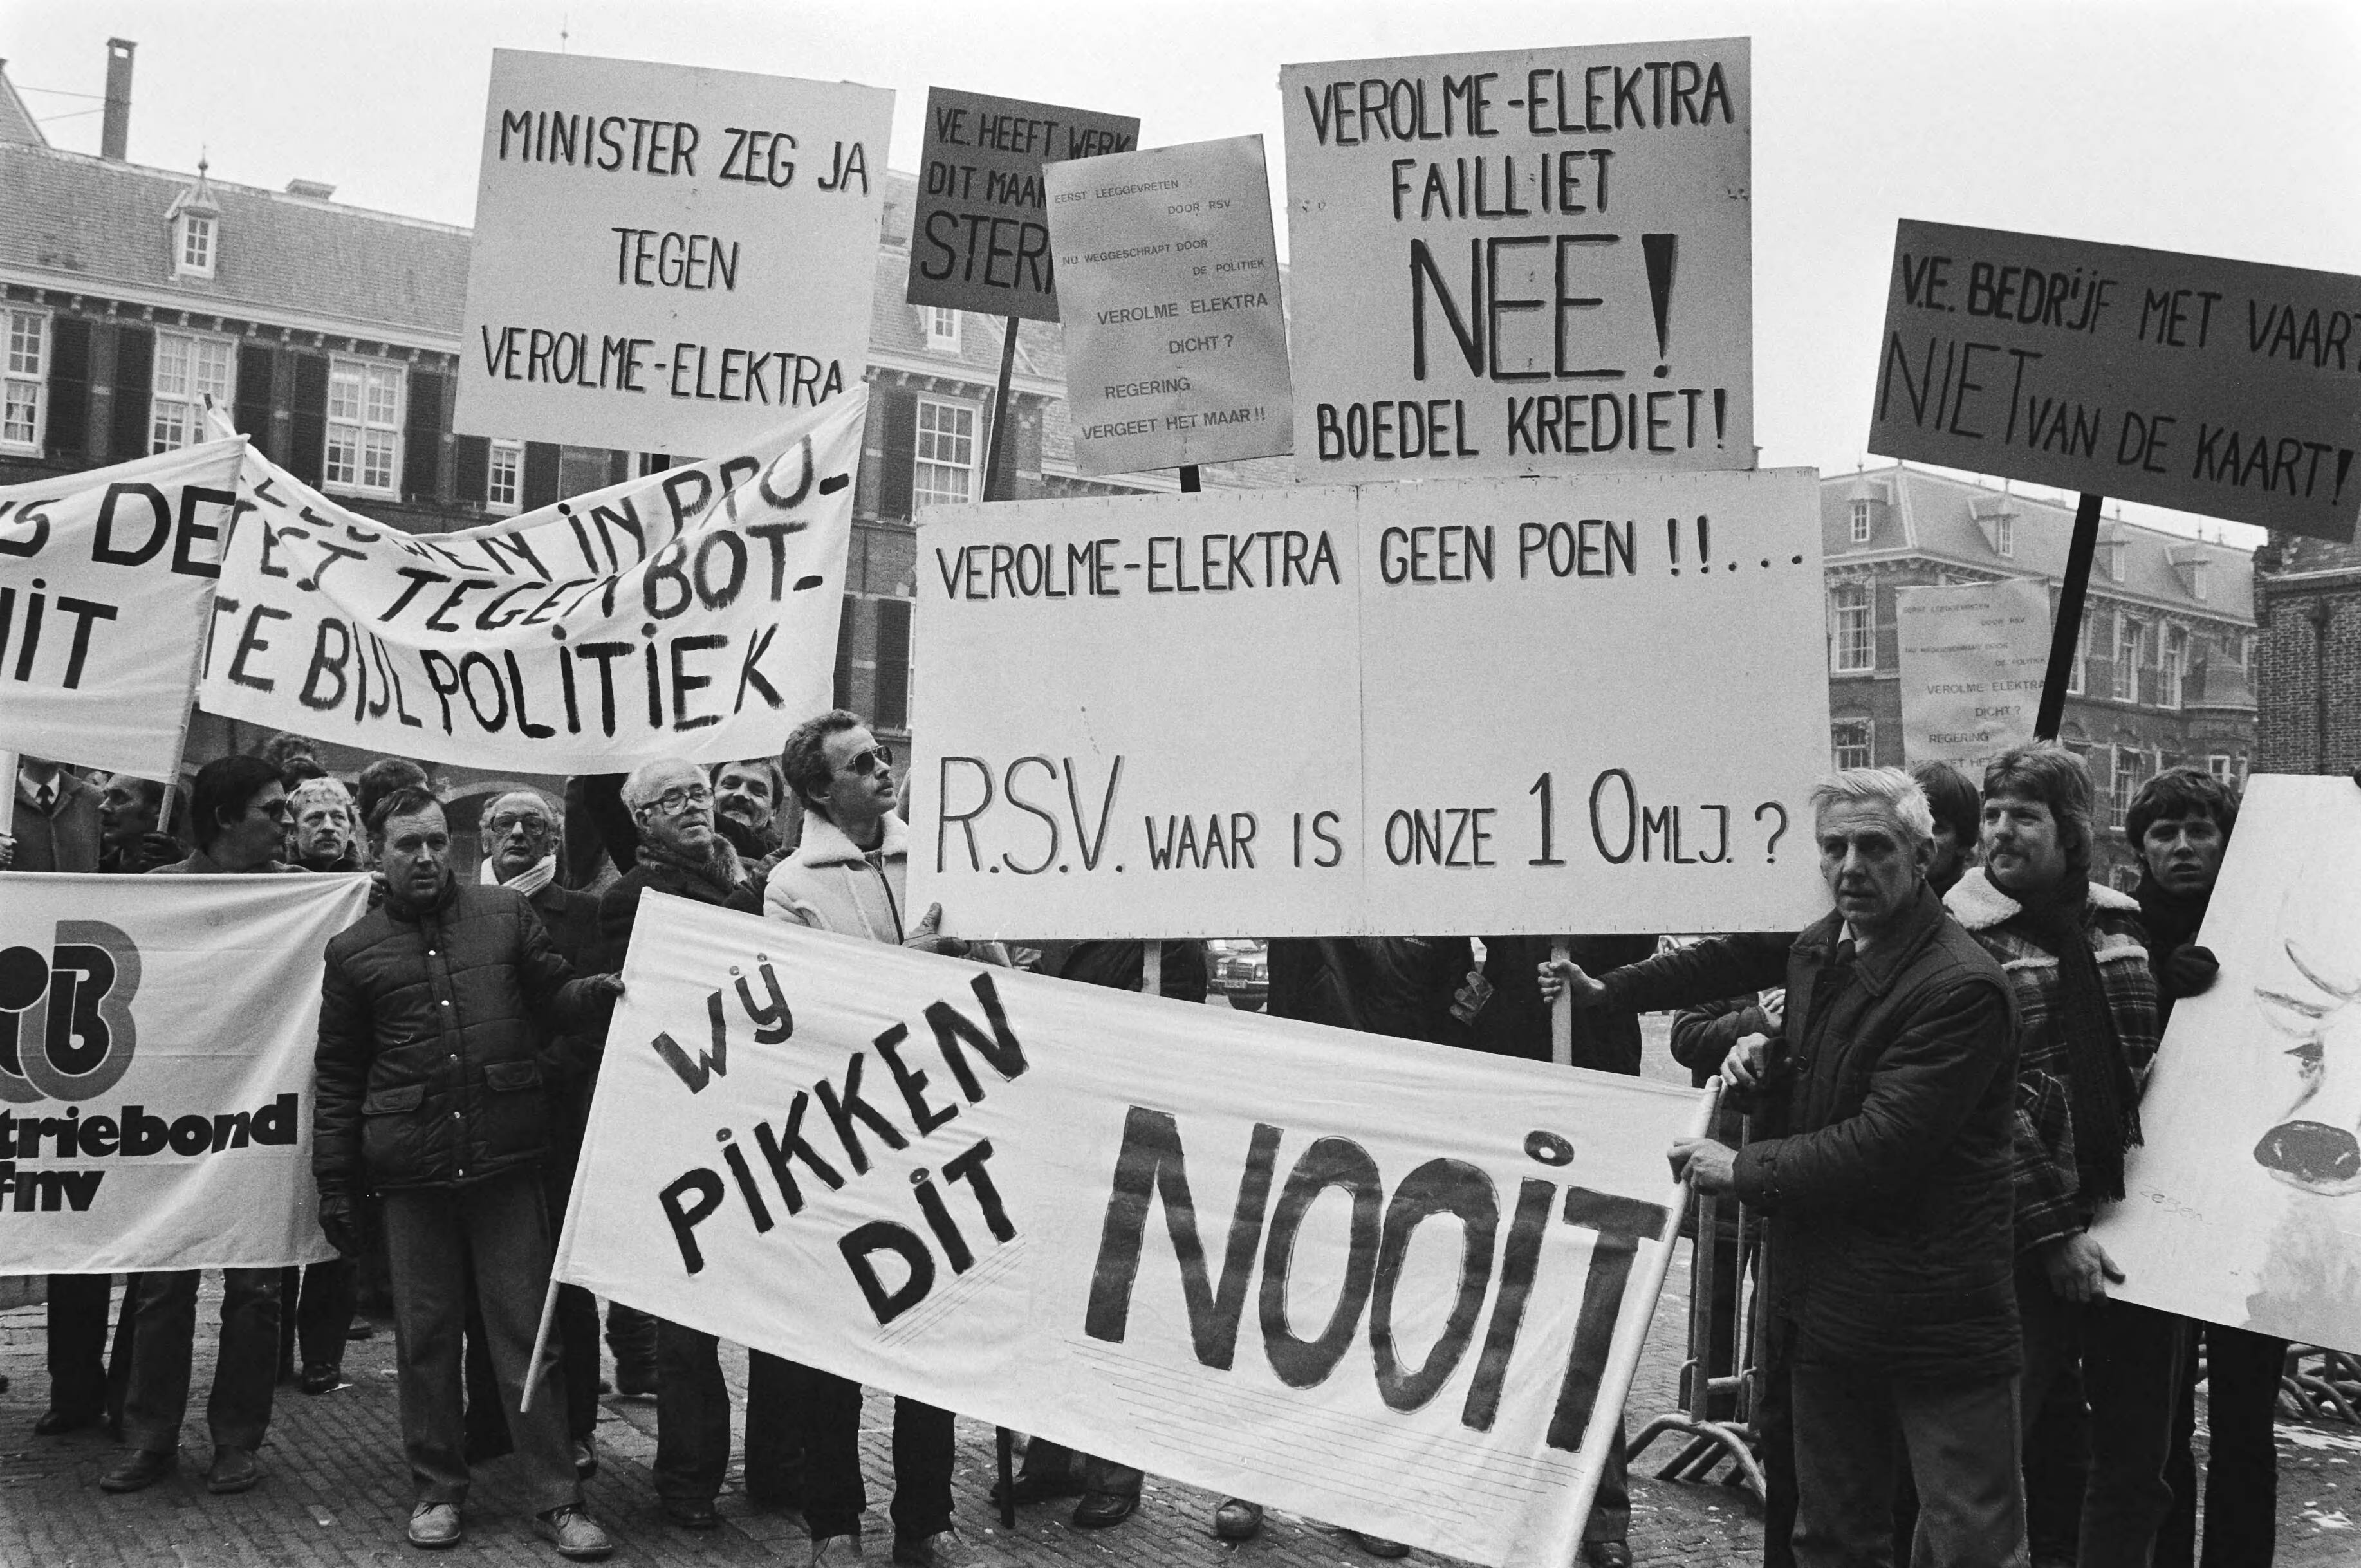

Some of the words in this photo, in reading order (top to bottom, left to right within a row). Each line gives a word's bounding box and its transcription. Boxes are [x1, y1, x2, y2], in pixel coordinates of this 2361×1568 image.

[1304, 60, 1734, 146] VEROLME-ELEKTRA
[499, 109, 698, 177] MINISTER
[719, 128, 798, 189] ZEG
[817, 141, 869, 197] JA
[978, 113, 1059, 156] HEEFT
[928, 161, 977, 200] DIT
[1055, 192, 1086, 203] EERST
[1096, 180, 1178, 198] LEEGGEVRETEN
[1392, 149, 1614, 221] FAILLIET
[1168, 203, 1200, 214] DOOR
[1208, 199, 1231, 210] RSV
[612, 227, 739, 291] TEGEN
[1063, 256, 1079, 265] NU
[1084, 244, 1171, 263] WEGGESCHRAPT
[1176, 239, 1208, 252] DOOR
[1193, 266, 1208, 275] DE
[1216, 259, 1265, 273] POLITIEK
[1097, 302, 1179, 324] VEROLME
[1191, 293, 1268, 314] ELEKTRA
[2139, 288, 2222, 348] MET
[481, 324, 845, 407] VEROLME-ELEKTRA
[1169, 335, 1218, 354] DICHT
[1105, 377, 1190, 399] REGERING
[1082, 418, 1158, 440] VERGEET
[1166, 415, 1198, 430] HET
[1204, 409, 1250, 427] MAAR
[1317, 400, 1479, 460] BOEDEL
[1880, 331, 2043, 445] NIET
[2029, 396, 2100, 459] VAN
[2118, 412, 2176, 472] DE
[2193, 423, 2354, 505] KAART!
[91, 483, 236, 579] DE
[936, 531, 1342, 600] VEROLME-ELEKTRA
[1380, 526, 1495, 586] GEEN
[1519, 519, 1637, 578] POEN
[203, 596, 292, 693] TE
[1927, 683, 1985, 694] VEROLME
[1976, 706, 2010, 717] DICHT
[1929, 732, 1989, 743] REGERING
[937, 755, 1124, 875] R.S.V.
[1145, 812, 1257, 869] WAAR
[1293, 811, 1342, 867] IS
[1385, 808, 1497, 869] ONZE
